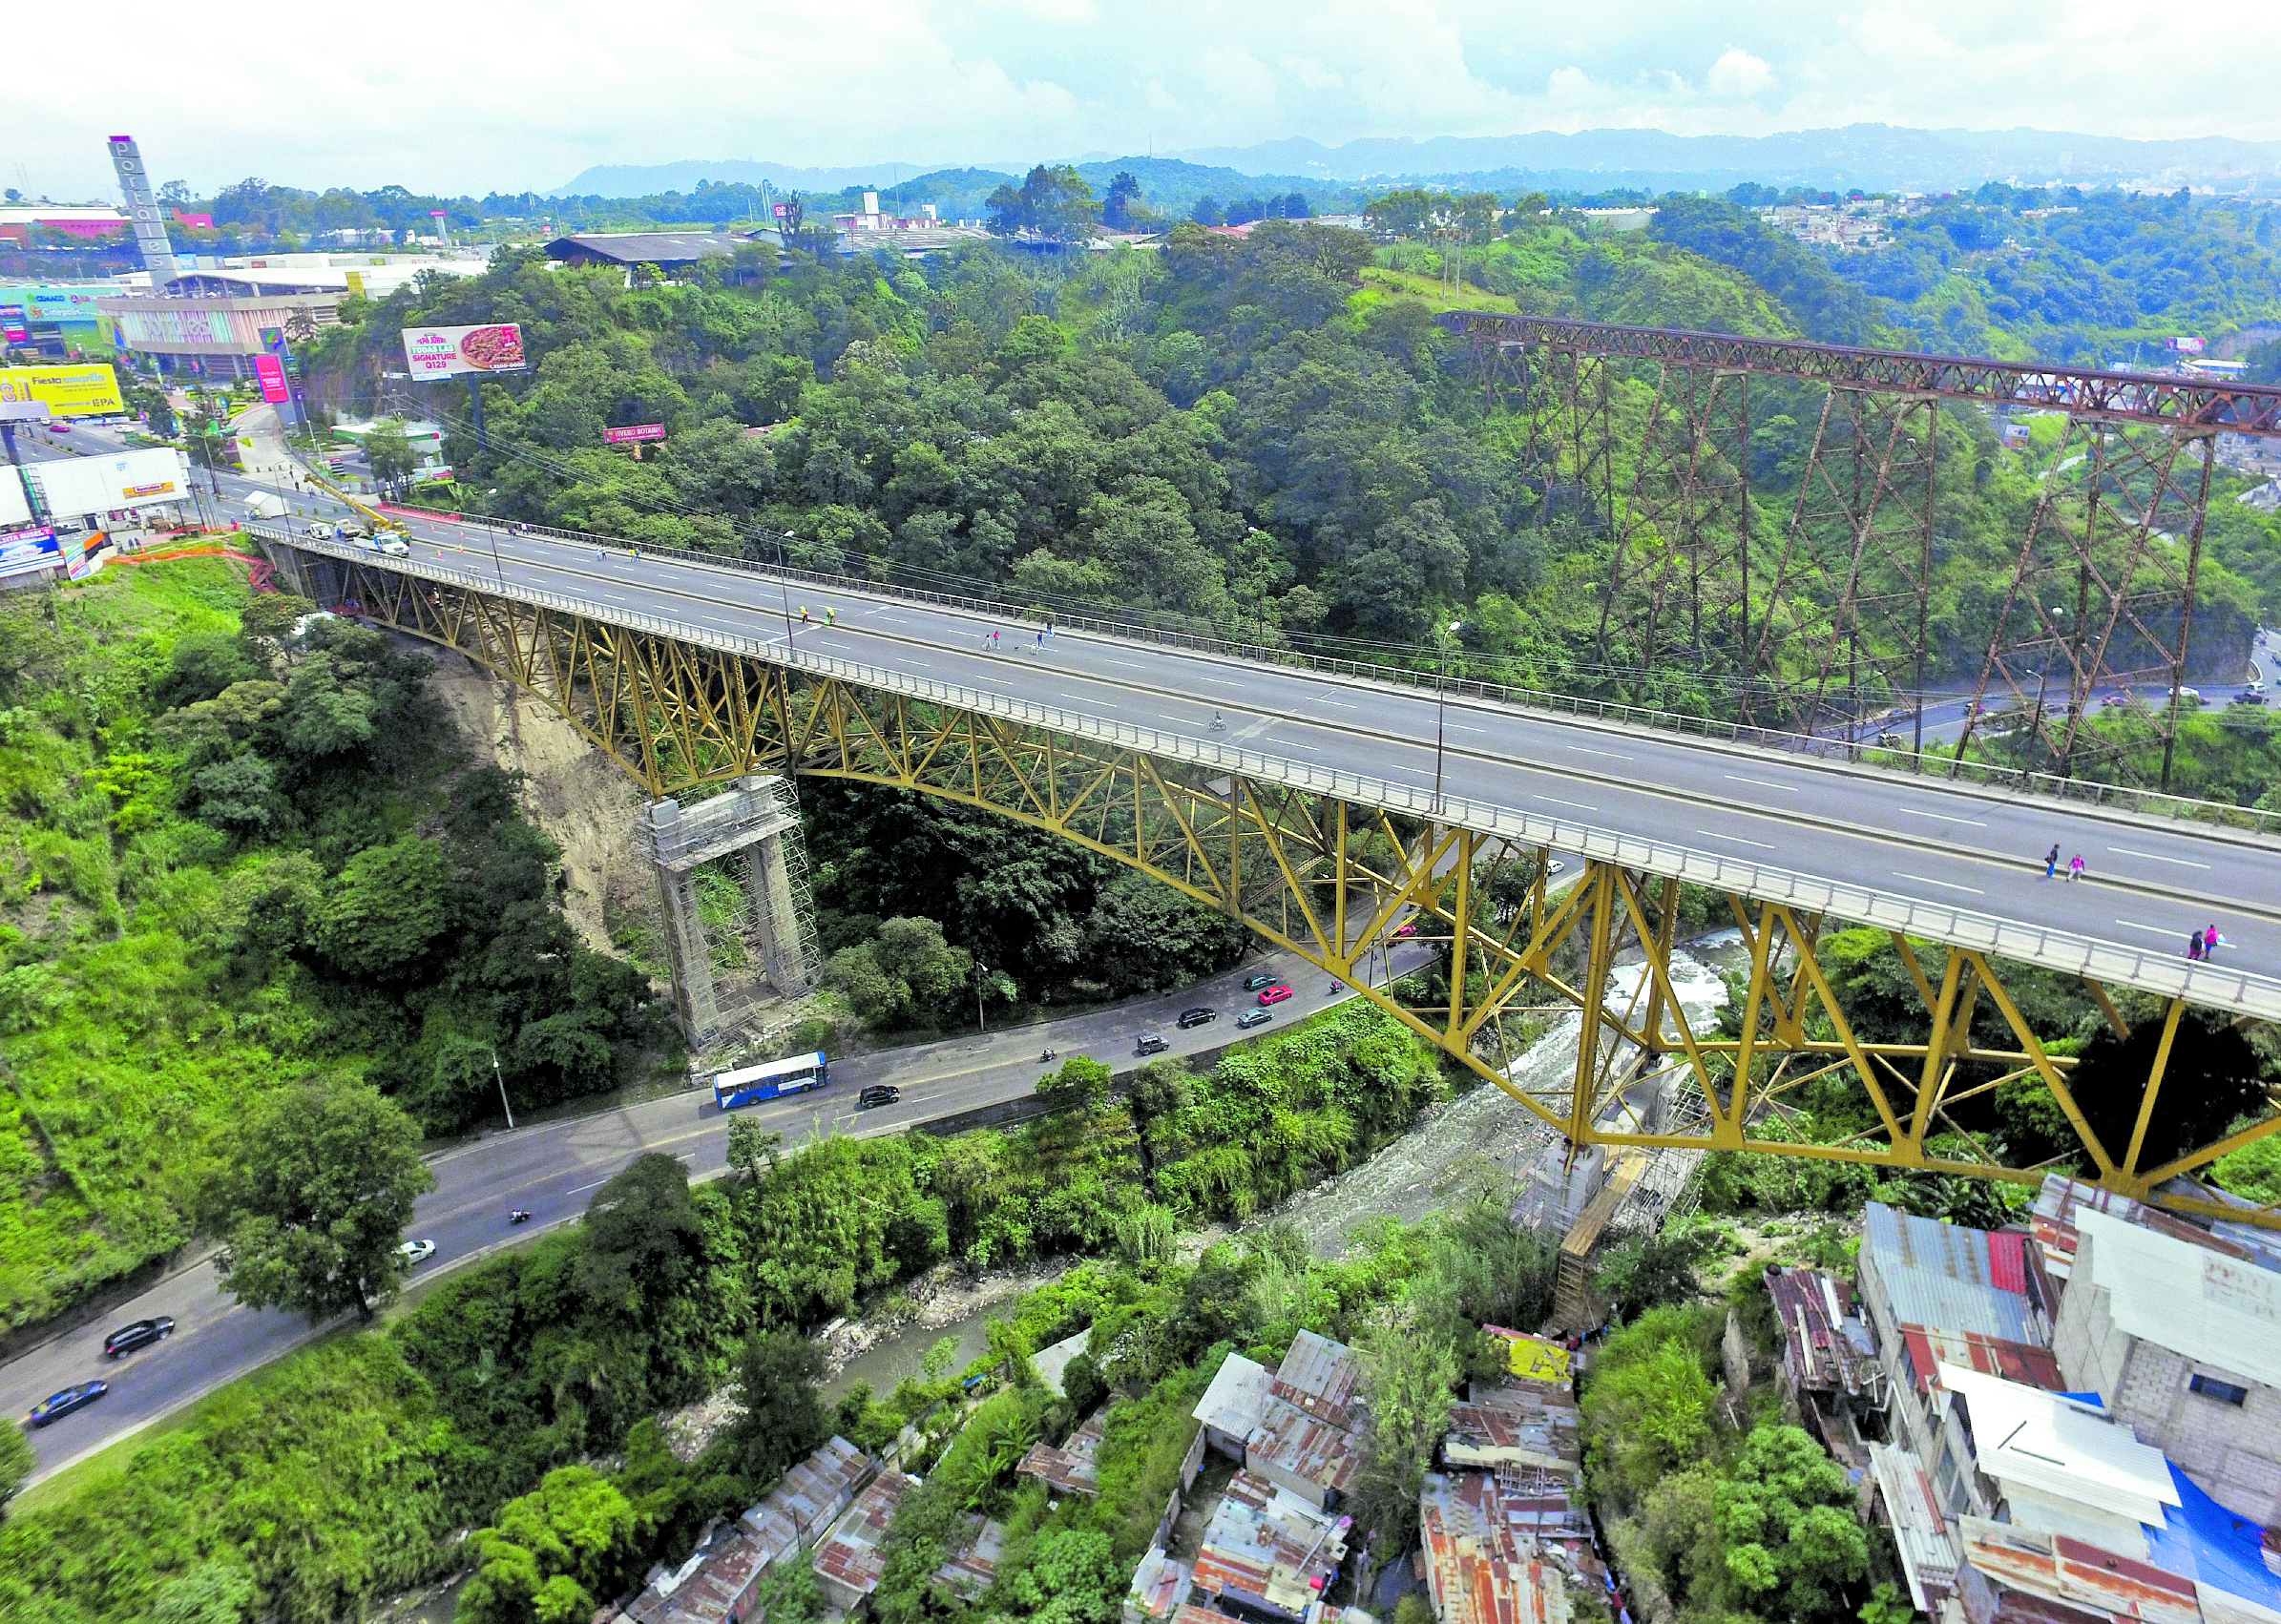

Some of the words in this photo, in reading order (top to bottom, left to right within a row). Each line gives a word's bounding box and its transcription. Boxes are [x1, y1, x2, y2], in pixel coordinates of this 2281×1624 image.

[411, 345, 438, 354] TODAS
[412, 353, 456, 362] SIGNATURE
[426, 361, 447, 369] Q129
